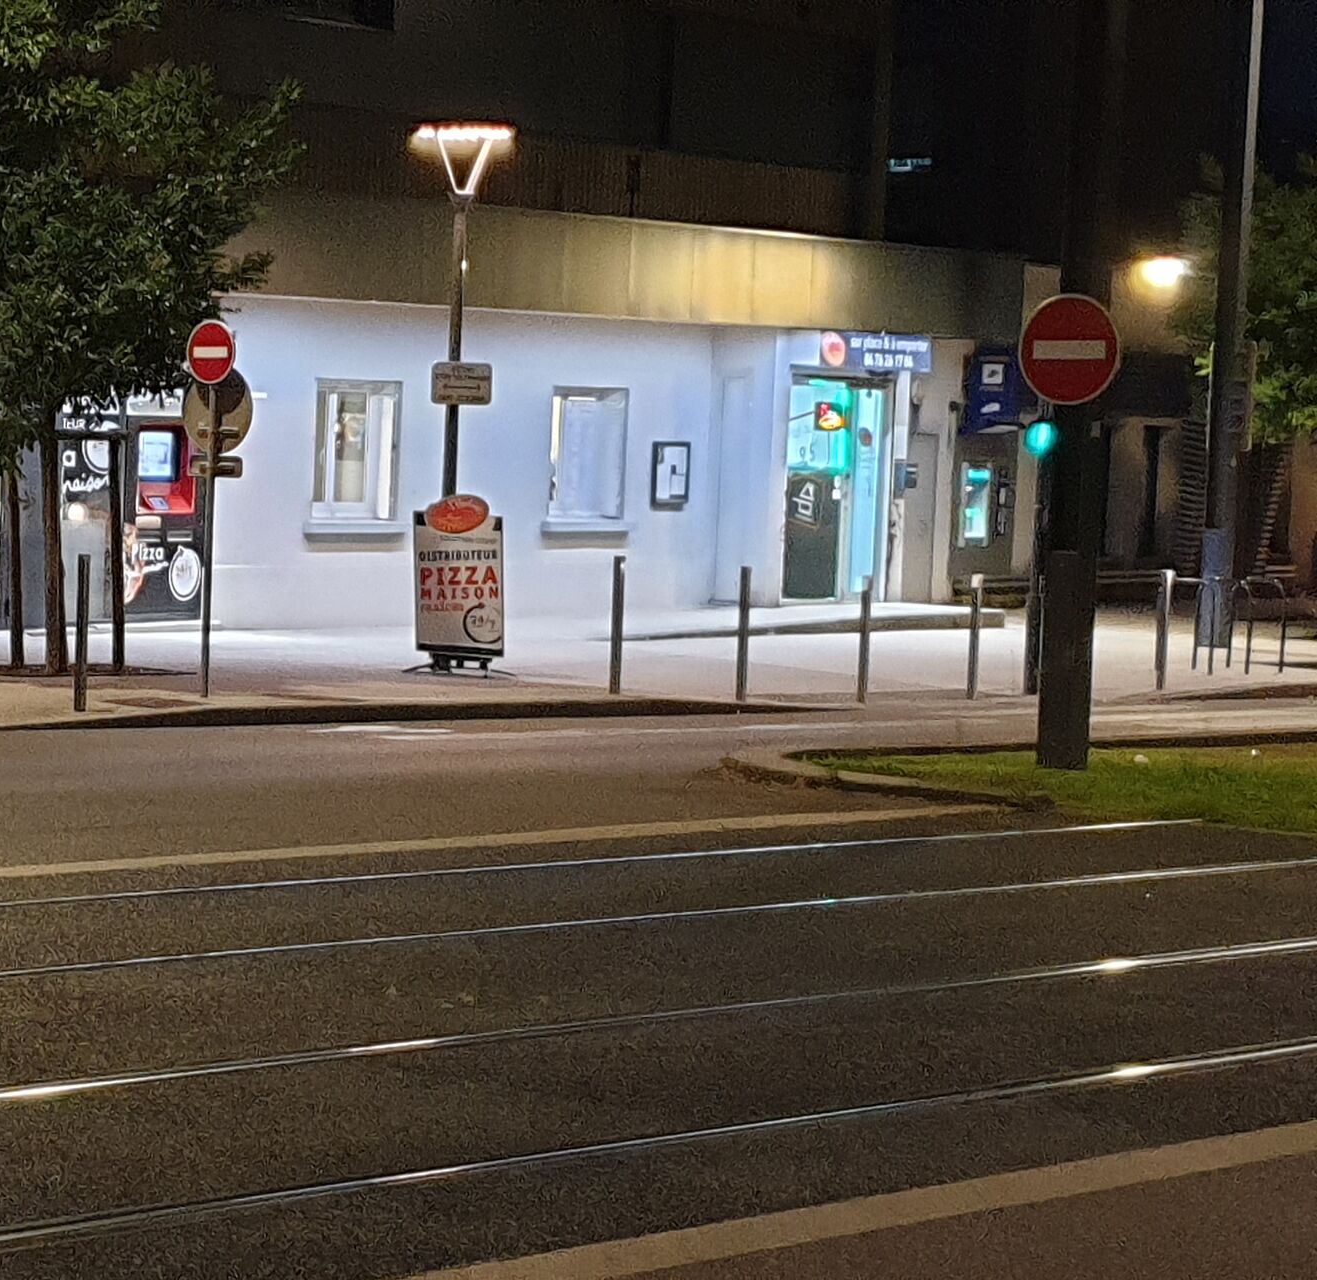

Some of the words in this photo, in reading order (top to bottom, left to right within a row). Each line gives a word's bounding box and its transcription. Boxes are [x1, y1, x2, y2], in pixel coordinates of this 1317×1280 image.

[419, 549, 497, 561] DISTRIBUTEUR
[420, 565, 498, 586] PIZZA
[420, 586, 499, 600] MAISON
